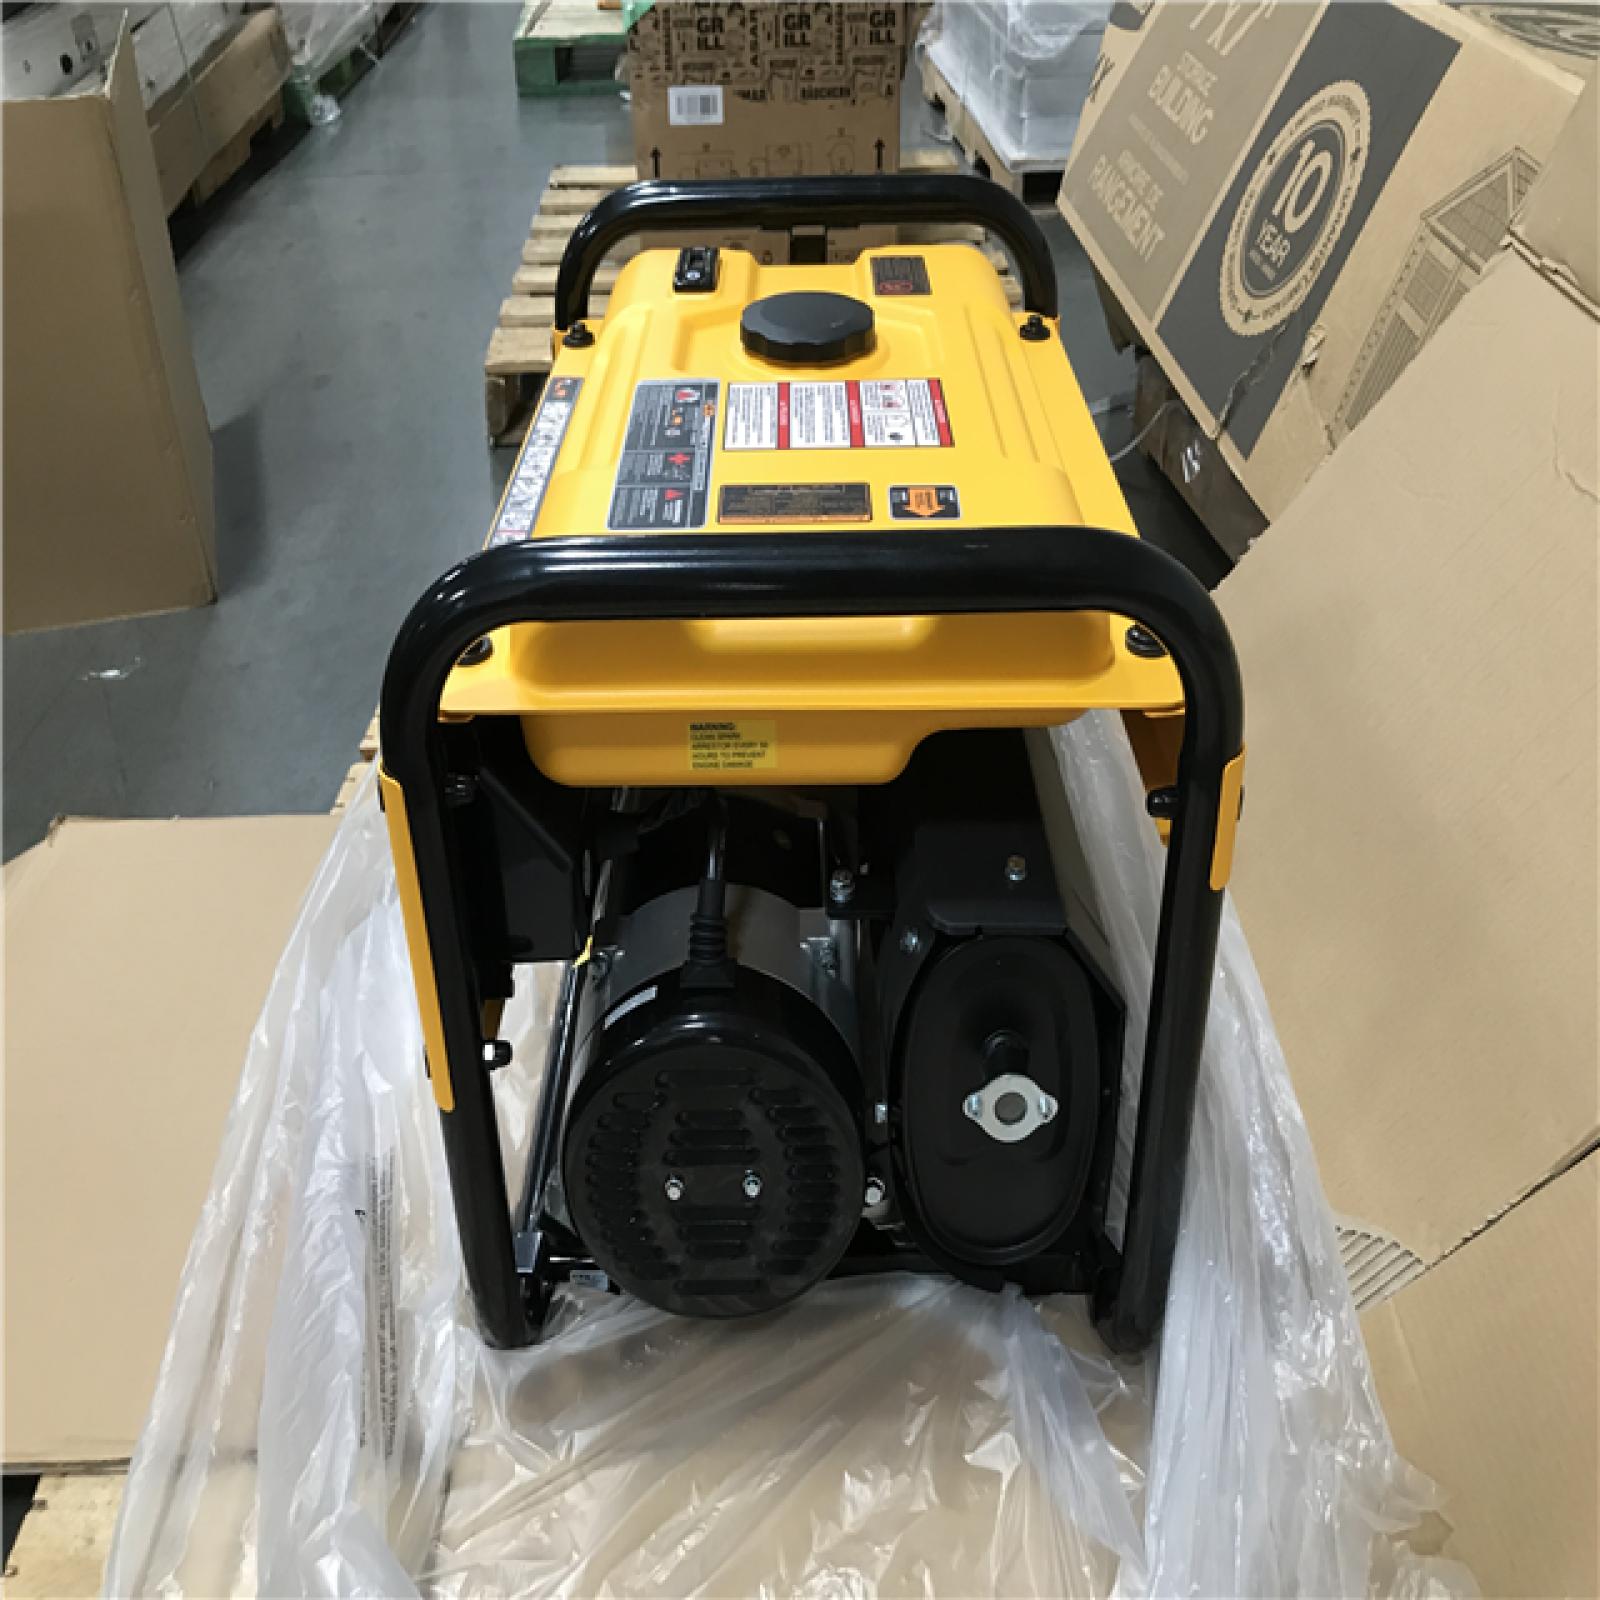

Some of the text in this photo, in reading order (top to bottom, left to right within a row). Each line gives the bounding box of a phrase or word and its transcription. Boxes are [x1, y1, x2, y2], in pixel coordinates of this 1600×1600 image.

[697, 16, 724, 33] GR
[784, 13, 811, 31] GR
[870, 10, 896, 28] GR
[697, 35, 725, 51] ILL
[784, 33, 811, 48] ILL
[870, 29, 896, 45] ILL
[1177, 50, 1218, 97] STORAGE
[1148, 64, 1214, 145] BUILDING
[1272, 138, 1332, 233] 10
[1087, 153, 1165, 263] RANGEMENT
[1255, 218, 1291, 268] YEAR
[690, 722, 735, 731] WARNING:
